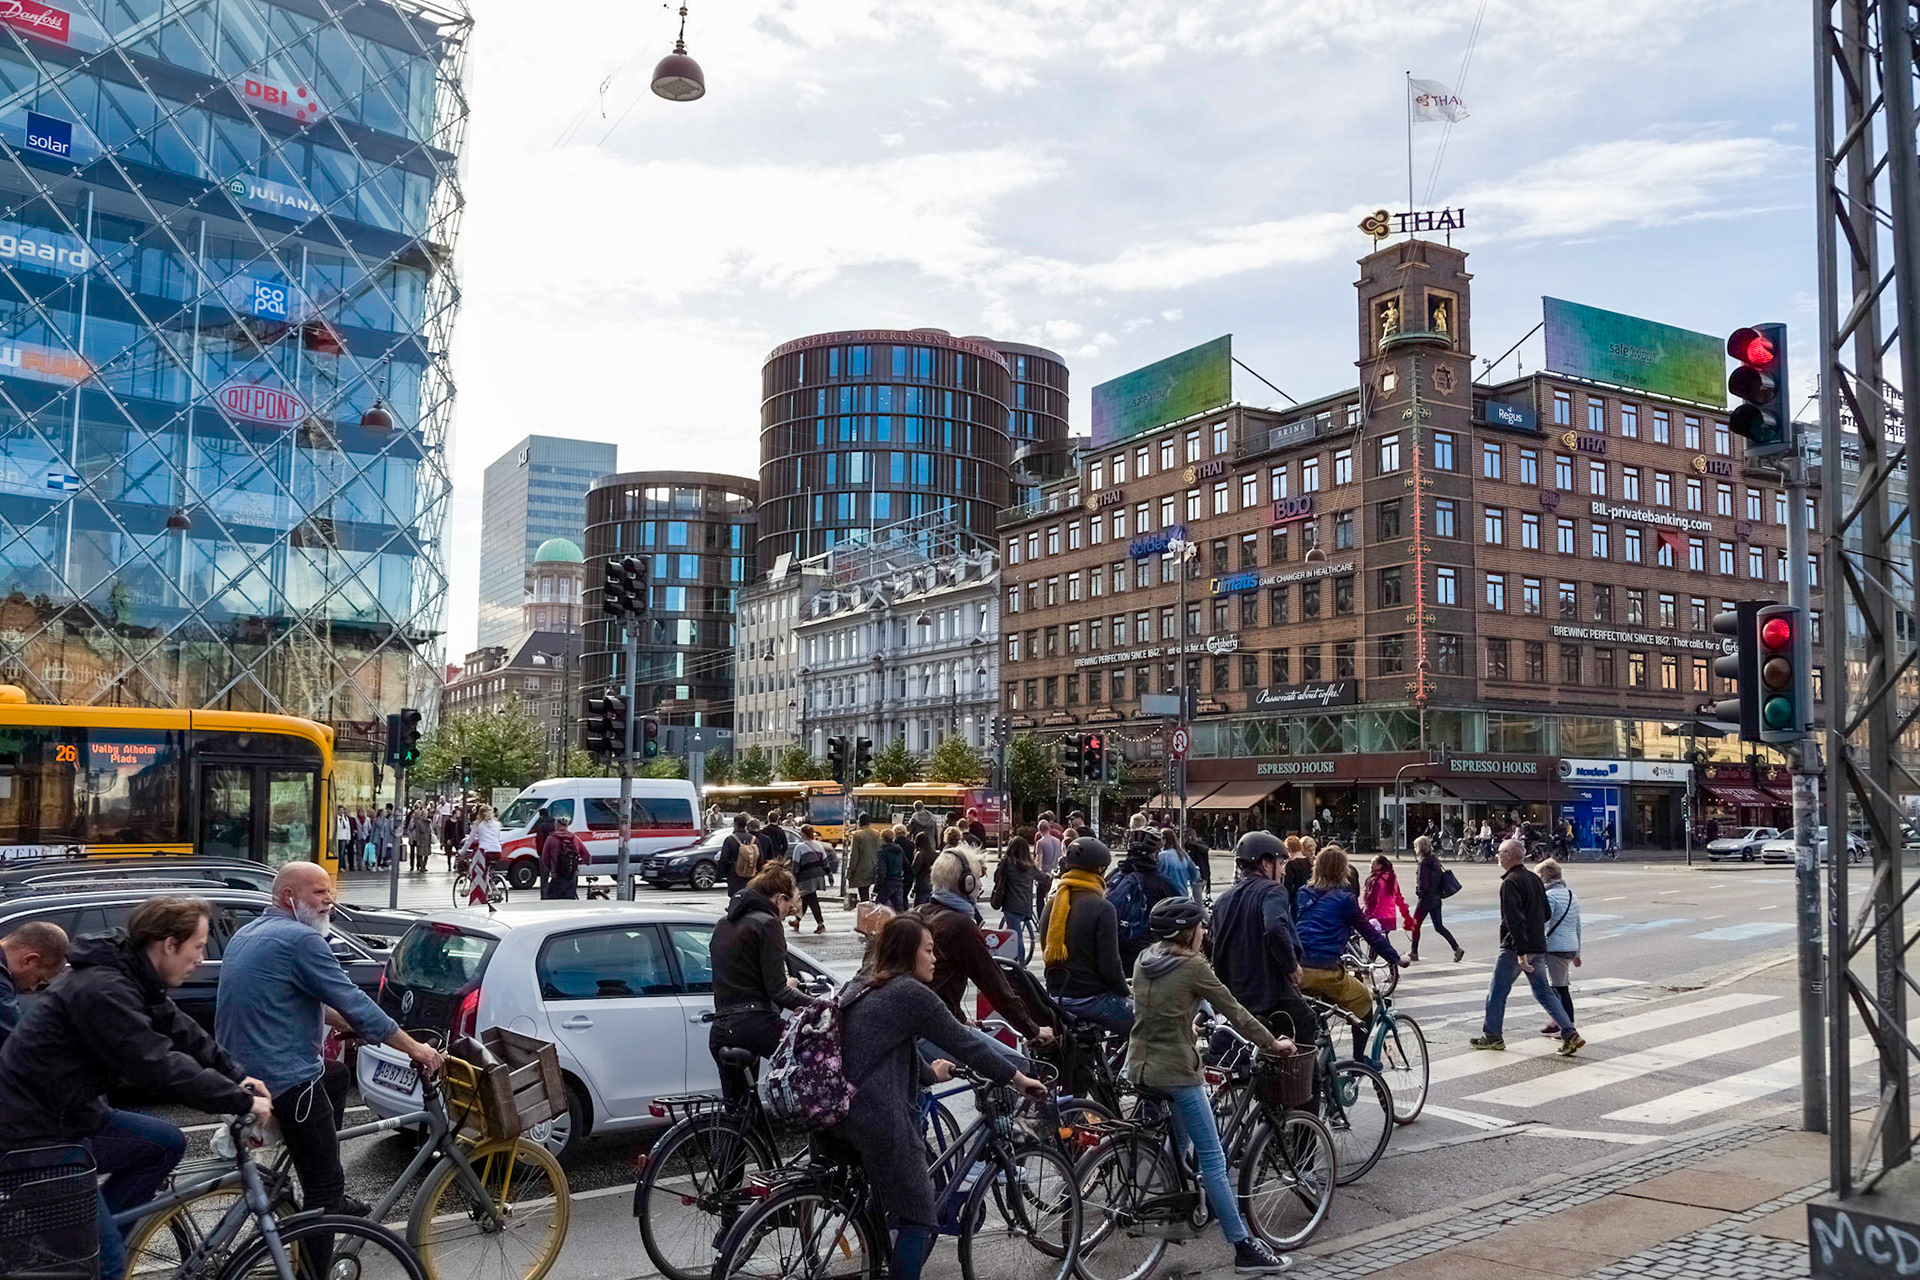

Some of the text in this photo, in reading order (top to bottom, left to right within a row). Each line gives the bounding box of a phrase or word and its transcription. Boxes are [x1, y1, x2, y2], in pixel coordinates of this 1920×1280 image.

[0, 0, 62, 27] Danfoss
[245, 79, 287, 106] DBI
[1431, 95, 1462, 106] THAI
[29, 135, 69, 153] solar
[249, 186, 321, 214] JULIANA
[1395, 209, 1465, 232] THAI
[0, 234, 88, 268] gaard
[858, 331, 942, 344] GORRISSEN
[1498, 408, 1522, 425] Regus
[1278, 423, 1306, 437] BRINK
[1196, 461, 1224, 479] THAI
[1100, 489, 1122, 506] THAI
[1275, 495, 1311, 519] BDO
[1592, 502, 1712, 532] BIL-privatebanking.com
[1259, 577, 1276, 587] GAME
[1277, 571, 1305, 583] CHANGER
[1306, 570, 1313, 578] IN
[1313, 563, 1353, 577] HEALTHCARE
[1554, 625, 1588, 638] BREWING
[1589, 629, 1633, 642] PERFECTION
[1634, 634, 1654, 645] SINCE
[1672, 637, 1688, 648] That
[1689, 638, 1703, 649] calls
[1705, 641, 1714, 650] for
[1722, 638, 1739, 655] Carls
[1074, 656, 1098, 667] BREWING
[1099, 652, 1130, 664] PERFECTION
[1131, 649, 1147, 660] SINCE
[1200, 643, 1205, 651] a
[1206, 636, 1238, 654] Carlsberg
[1256, 683, 1344, 706] Passionate about coffee!
[56, 745, 76, 762] 26
[92, 744, 156, 755] Valby Alholm
[110, 754, 137, 764] Plads
[1258, 761, 1334, 774] ESPRESSO HOUSE
[1450, 759, 1537, 773] ESPRESSO HOUSE
[1576, 767, 1609, 777] Nordea
[1660, 768, 1675, 776] THAI
